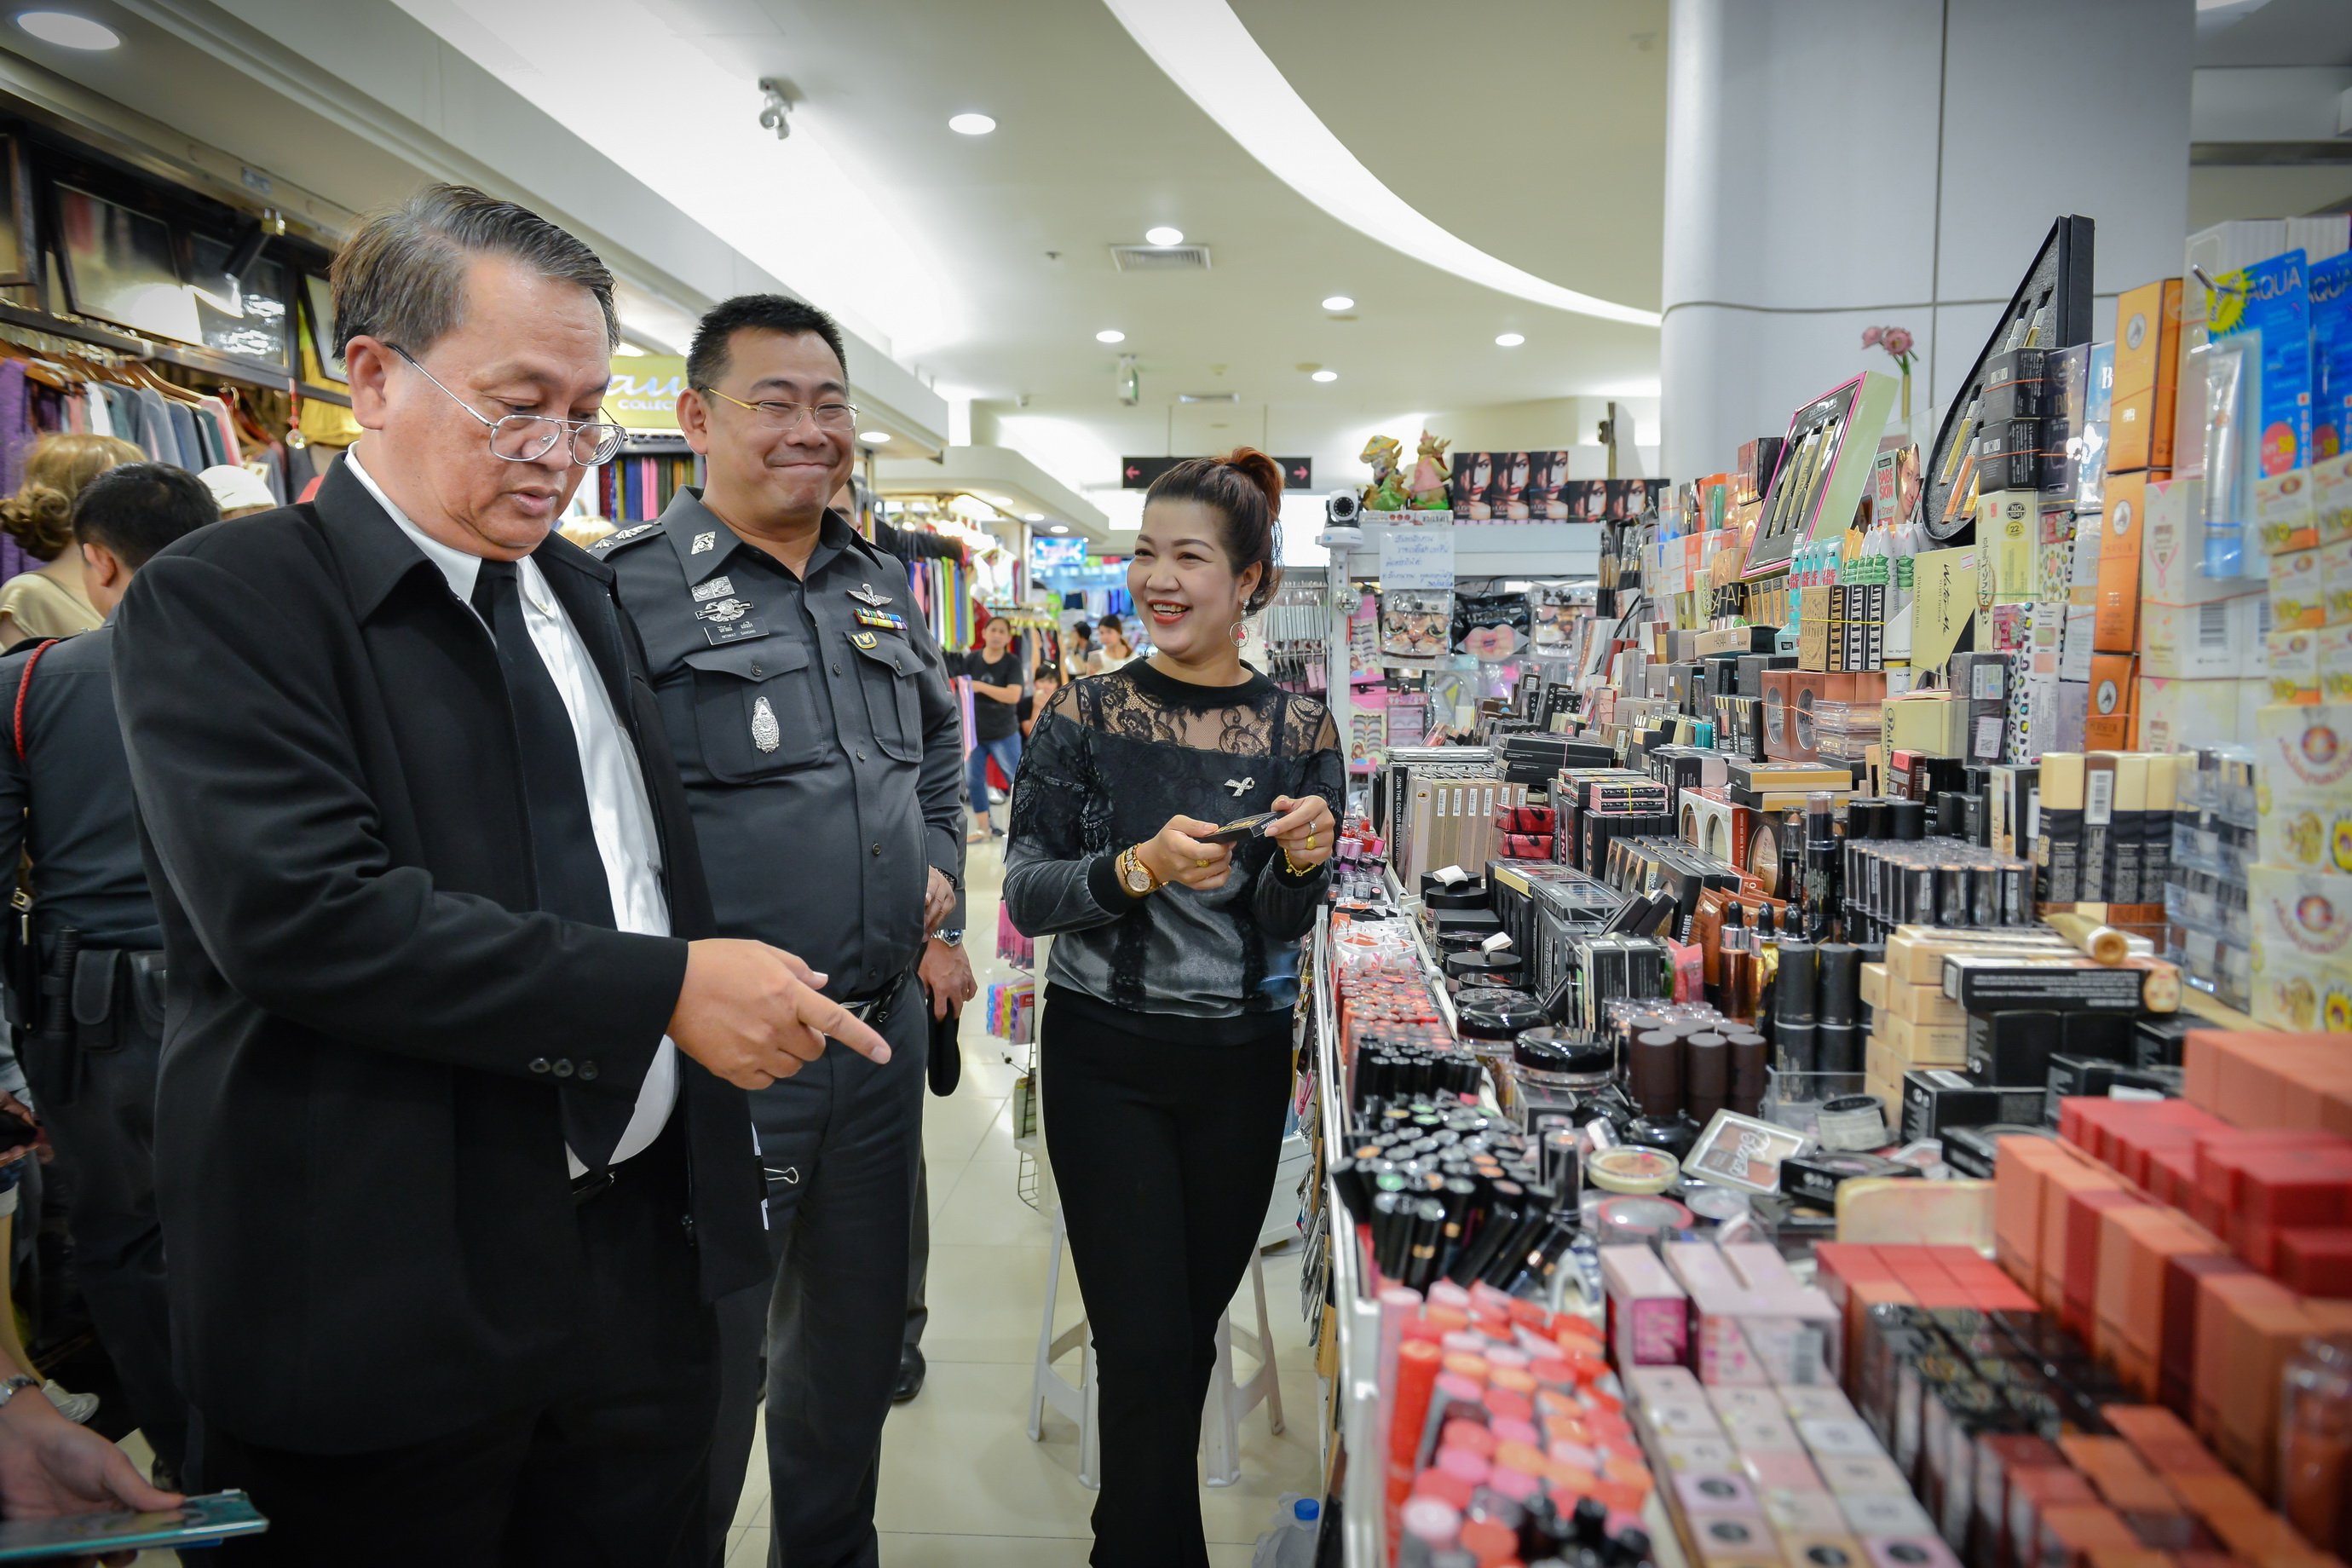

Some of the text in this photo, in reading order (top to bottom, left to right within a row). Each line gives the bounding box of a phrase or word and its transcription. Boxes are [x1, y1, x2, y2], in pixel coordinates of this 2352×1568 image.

[1878, 468, 1894, 486] BABE
[1879, 484, 1894, 501] SKIN
[1682, 914, 1692, 935] COLORS
